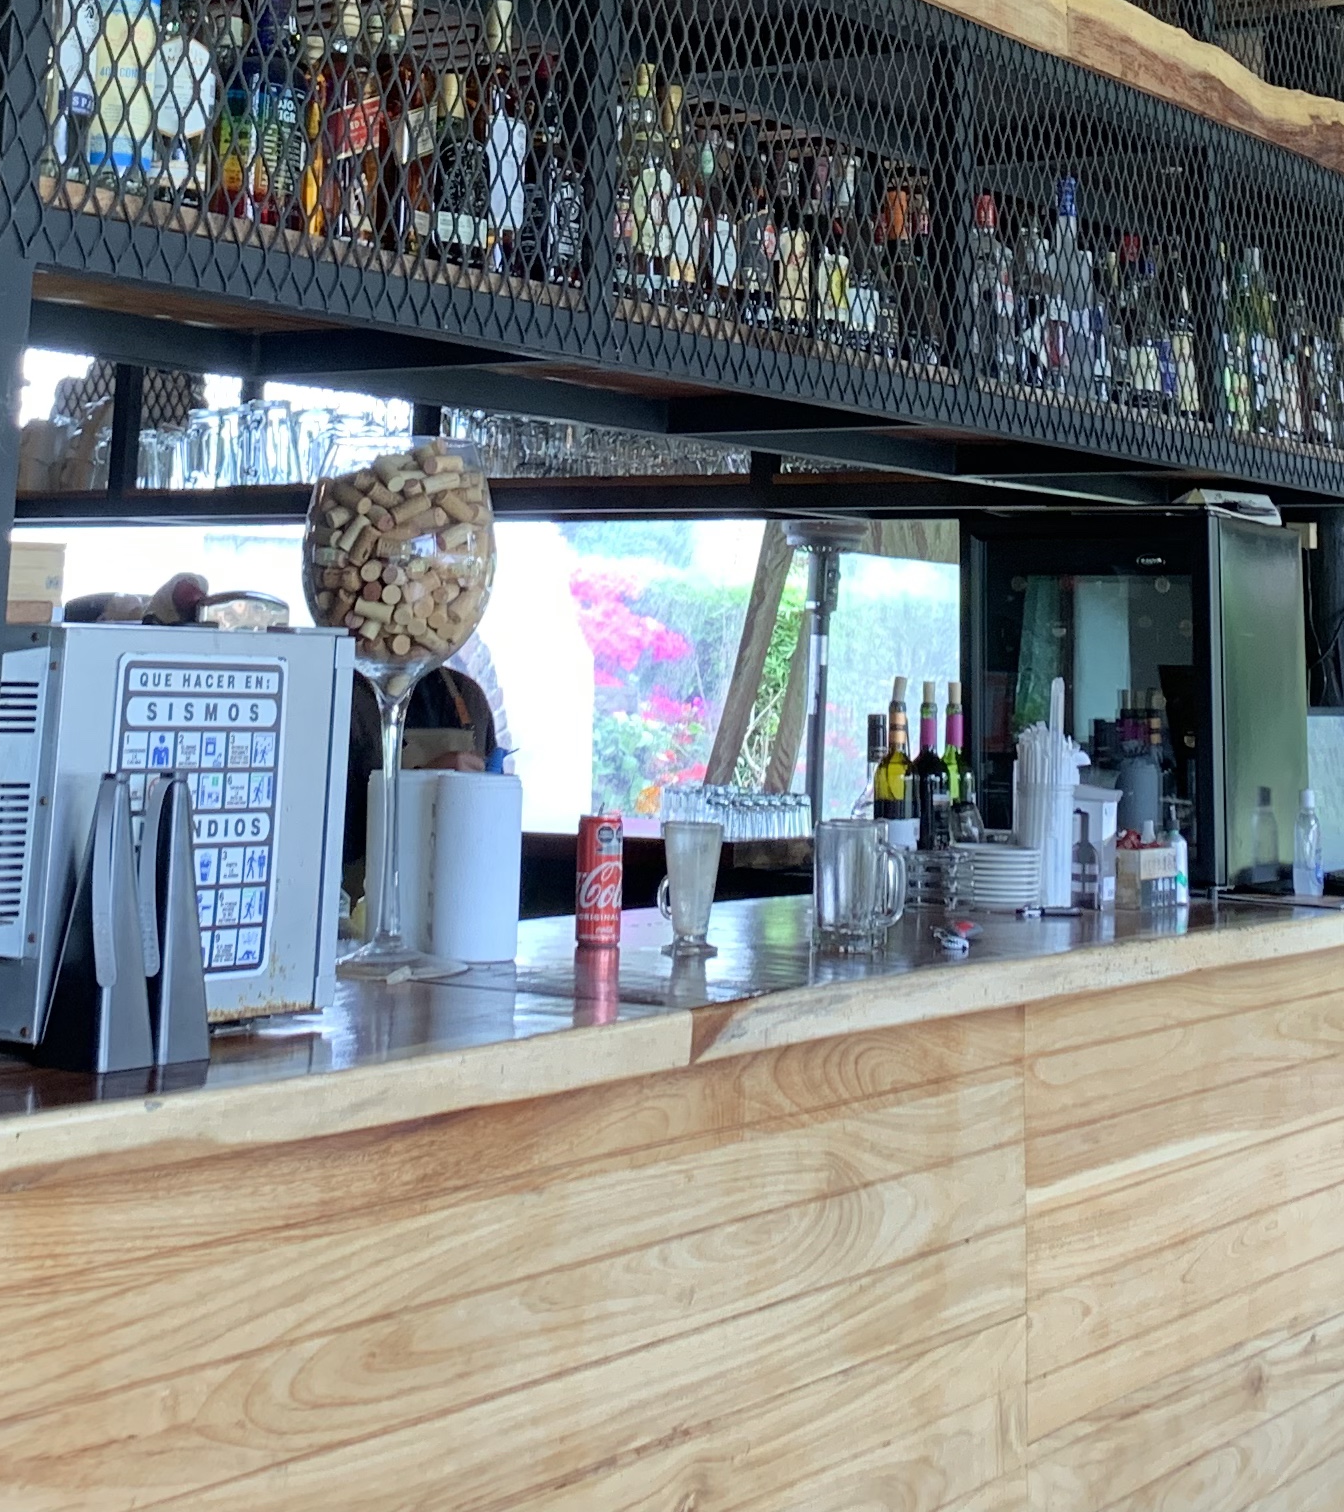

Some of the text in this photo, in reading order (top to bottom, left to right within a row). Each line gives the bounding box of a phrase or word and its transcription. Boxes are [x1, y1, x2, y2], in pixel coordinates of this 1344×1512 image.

[140, 672, 271, 690] QUE HACER EN:
[146, 701, 260, 723] SISMOS
